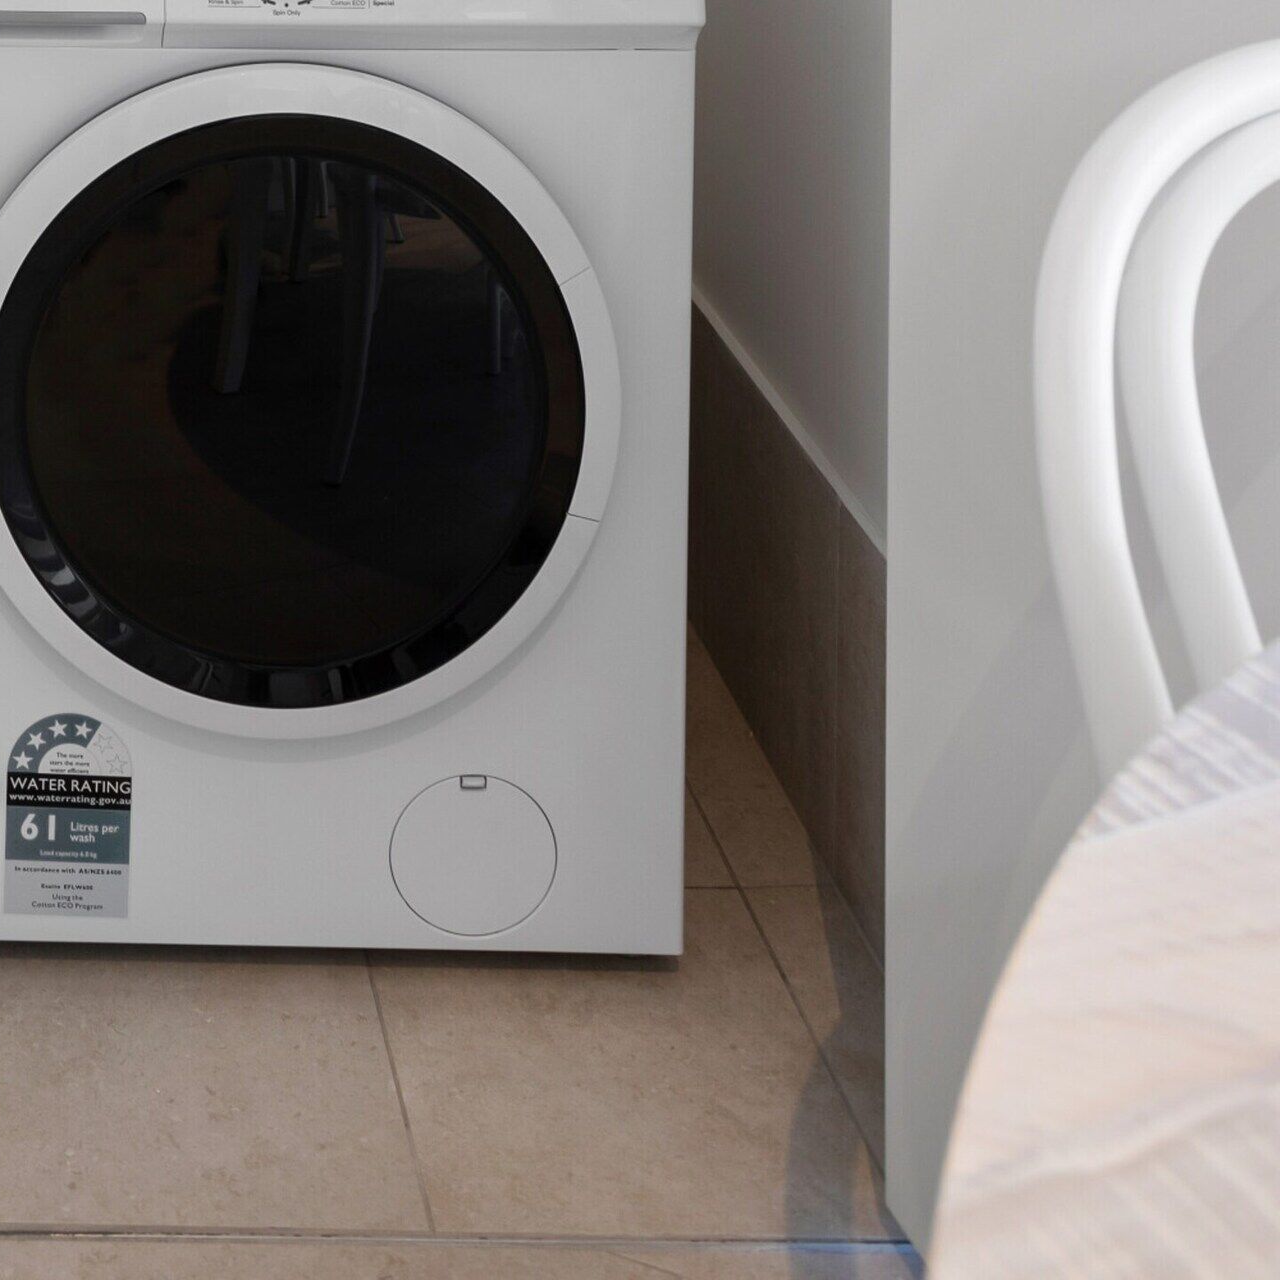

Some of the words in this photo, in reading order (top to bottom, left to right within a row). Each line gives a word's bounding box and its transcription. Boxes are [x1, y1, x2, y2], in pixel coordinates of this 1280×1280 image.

[10, 777, 67, 792] WATER
[71, 779, 131, 795] RATING
[9, 793, 132, 806] www.waterrating.gov.au
[70, 822, 99, 833] Litres
[102, 825, 119, 835] per
[70, 833, 95, 842] wash
[52, 894, 71, 902] Using
[57, 901, 73, 909] ECO
[75, 903, 103, 911] Program
